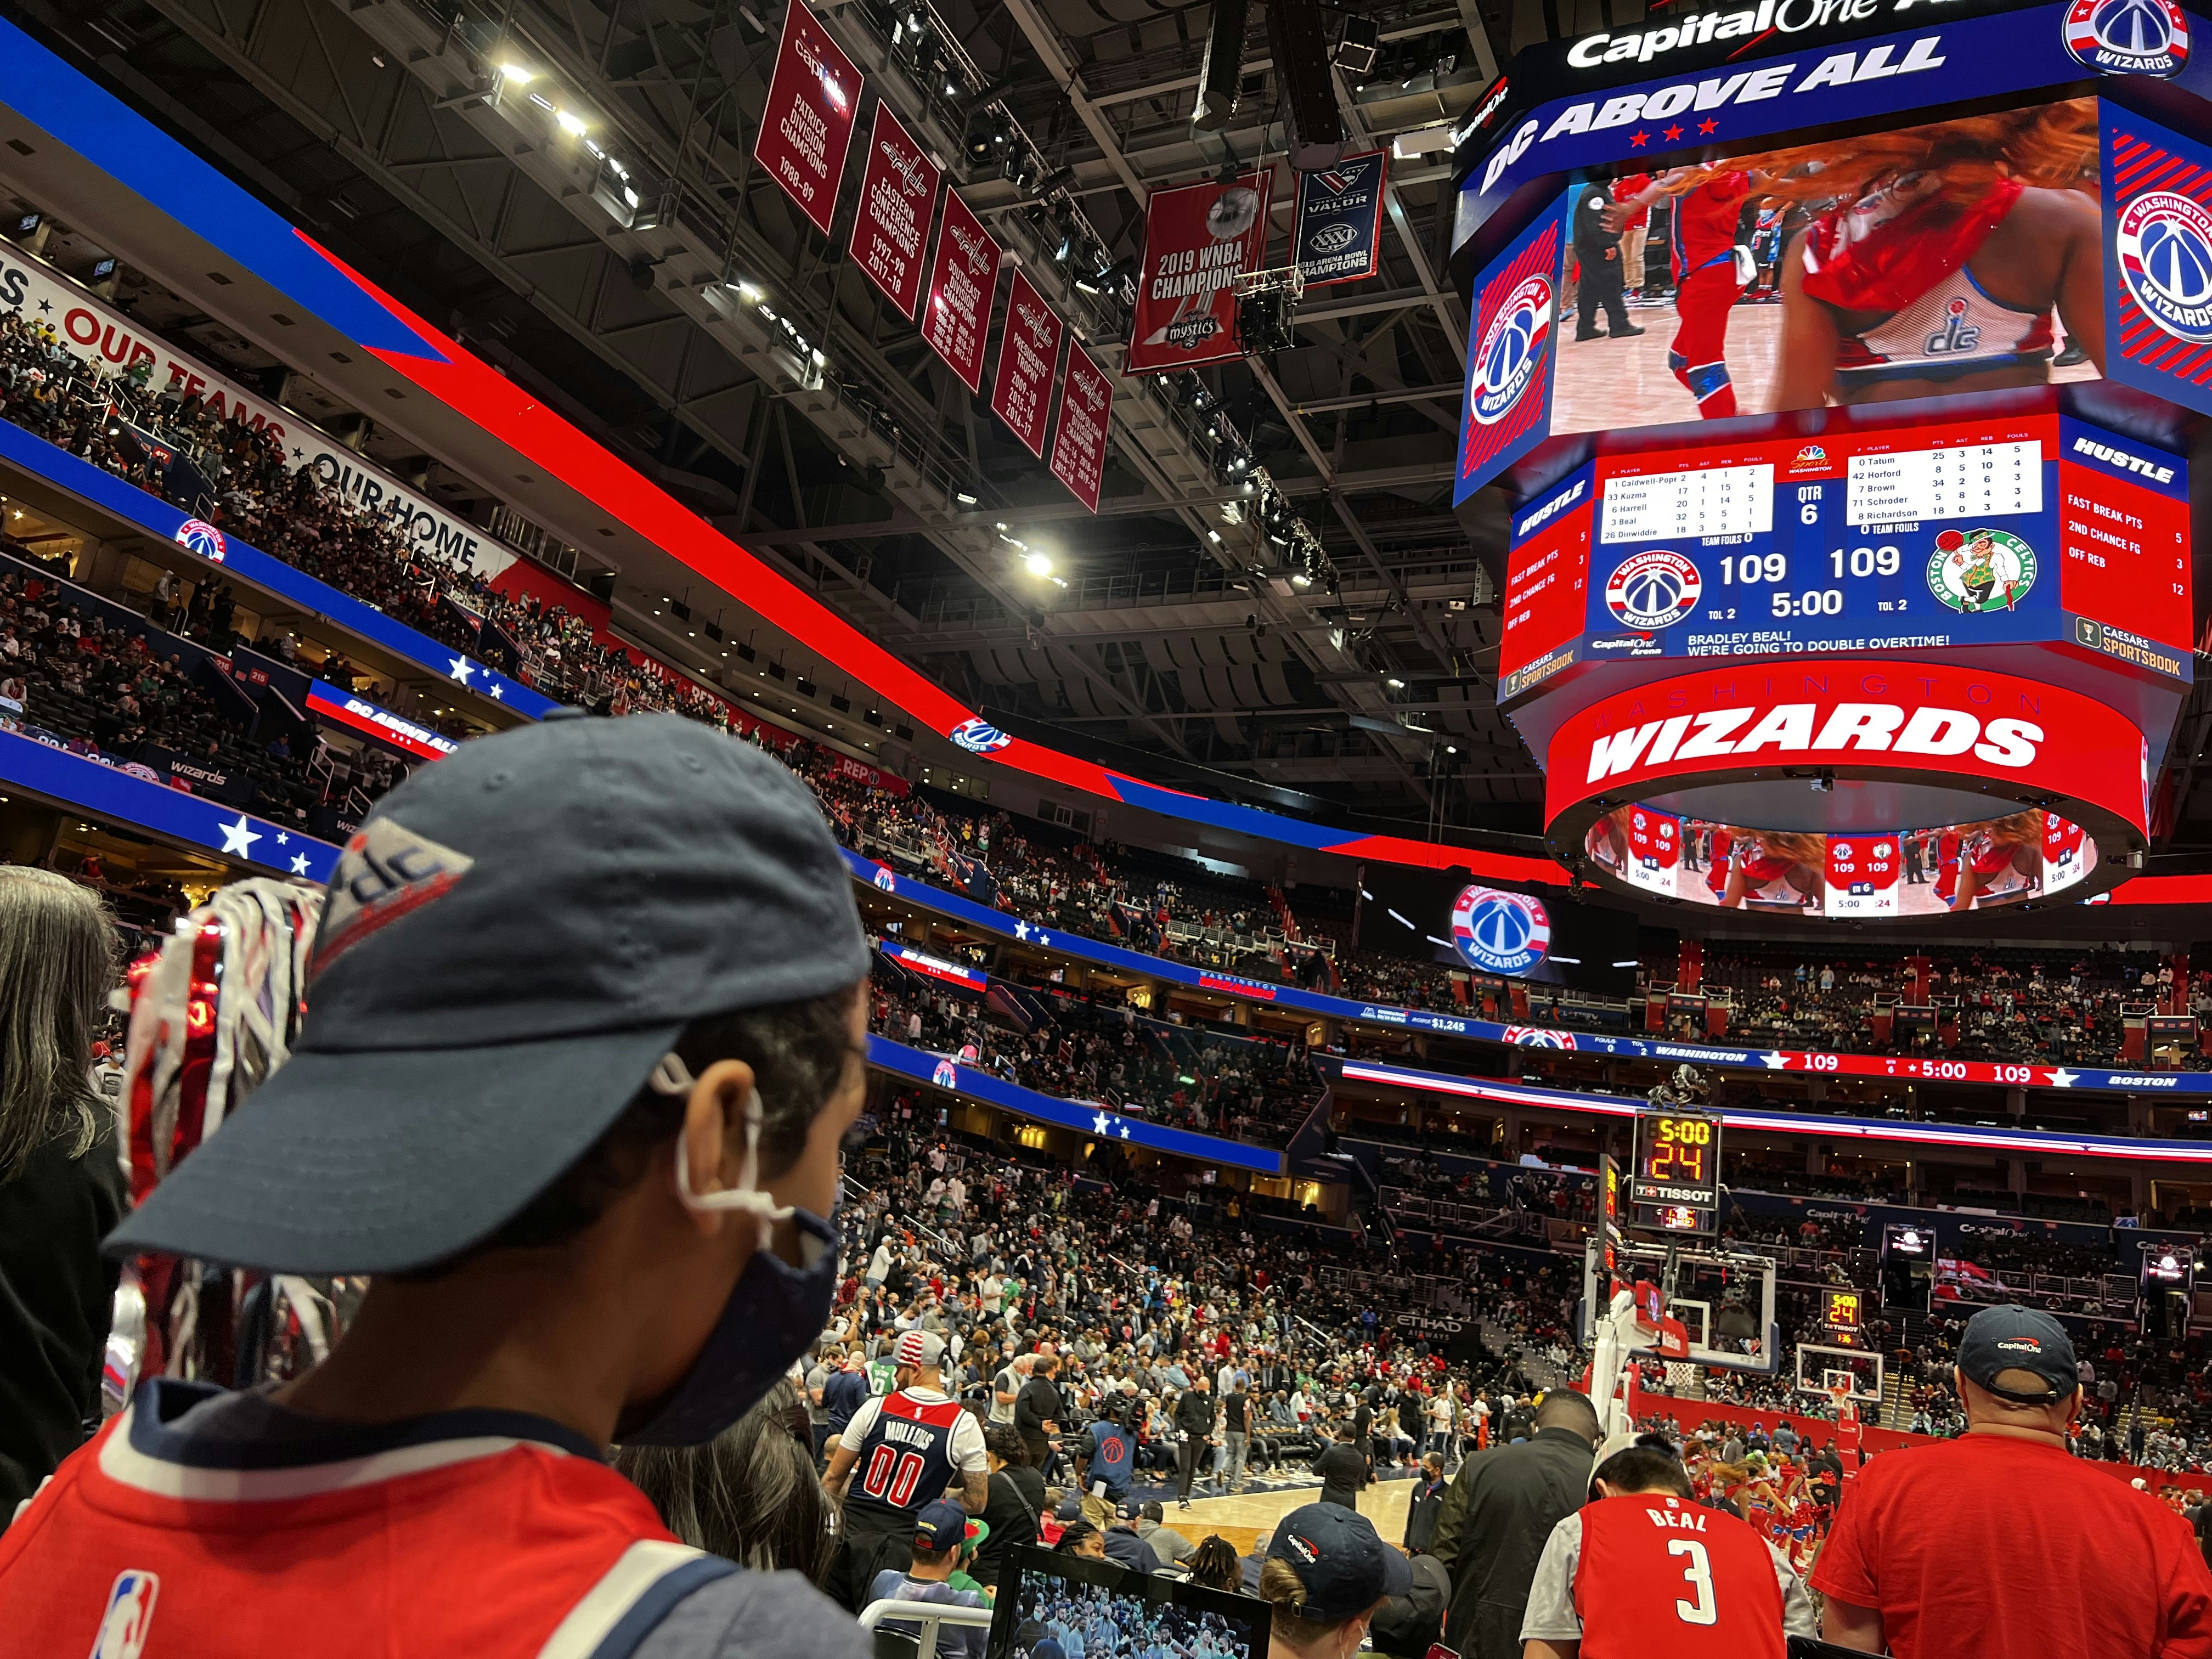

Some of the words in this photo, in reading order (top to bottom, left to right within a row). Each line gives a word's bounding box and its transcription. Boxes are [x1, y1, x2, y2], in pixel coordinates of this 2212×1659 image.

[2094, 49, 2174, 70] WIZARDS
[794, 93, 827, 141] PATRICK
[1480, 120, 1539, 196] DC
[1540, 63, 1797, 143] ABOVE
[1794, 36, 1946, 93] ALL
[790, 107, 826, 158] DIVISION
[780, 116, 827, 179] CHAMPIONS
[780, 155, 814, 202] 1988-89
[881, 177, 915, 221] EASTERN
[1308, 195, 1367, 213] VALOR
[871, 184, 921, 248] CONFERENCE
[870, 201, 915, 259] CHAMPIONS
[872, 233, 905, 277] 1997-98
[1158, 249, 1195, 276] 2019
[1199, 240, 1243, 268] WNBA
[1316, 255, 1344, 266] ARENA
[1344, 250, 1368, 261] BOWL
[868, 250, 902, 294] 2017-18
[948, 258, 981, 303] SOUTHEAST
[943, 283, 977, 329] CHAMPIONS
[1485, 282, 1541, 346] WASHINGTON
[1017, 352, 1039, 385] TROPHY
[1011, 370, 1037, 407] 2009-10
[1481, 357, 1532, 411] WIZARDS
[1008, 386, 1034, 423] 2015-16
[1066, 394, 1103, 442] METROPOLITAN
[1005, 402, 1032, 438] 2016-17
[1066, 422, 1096, 460] CHAMPIONS
[1789, 466, 1833, 474] WASHINGTON
[1790, 458, 1831, 469] Sports
[1859, 458, 1865, 466] 0
[1868, 457, 1895, 466] Tatum
[2073, 437, 2175, 484] HUSTLE
[1852, 472, 1865, 480] 42
[1867, 469, 1901, 479] Horford
[1867, 483, 1895, 493] Brown
[1518, 479, 1586, 537] HUSTLE
[1620, 504, 1647, 512] Harrell
[1621, 492, 1647, 500] Kuzma
[1797, 485, 1822, 504] QTR
[1867, 496, 1909, 506] Schroder
[1800, 504, 1819, 525] 6
[1858, 512, 1864, 521] 8
[1867, 509, 1918, 520] Richardson
[1860, 523, 1870, 535] 0
[1872, 524, 1893, 535] TEAM
[1894, 521, 1920, 533] FOULS
[2068, 494, 2091, 511] FAST
[2093, 501, 2124, 522] BREAK
[2125, 514, 2143, 529] PTS
[2175, 533, 2182, 543] 5
[391, 495, 478, 566] HOME
[1618, 528, 1658, 538] Dinwiddie
[1702, 537, 1720, 546] TEAM
[1721, 535, 1742, 545] FOULS
[1743, 532, 1753, 543] 0
[2068, 520, 2088, 535] 2ND
[2090, 528, 2127, 550] CHANCE
[2129, 541, 2141, 555] FG
[2176, 558, 2183, 569] 3
[1618, 554, 1691, 577] WASHINGTON
[1719, 552, 1787, 585] 109
[1830, 545, 1901, 579] 109
[2006, 538, 2032, 588] CELTICS
[2068, 546, 2086, 561] OFF
[2087, 553, 2106, 568] REB
[2172, 583, 2184, 596] 12
[1929, 550, 1951, 602] BOSTON
[1708, 611, 1723, 620] TOL
[1726, 608, 1736, 619] 2
[1771, 589, 1843, 618] 5:00
[1878, 601, 1894, 612] TOL
[1898, 599, 1908, 611] 2
[1622, 608, 1681, 627] WIZARDS
[1688, 633, 1748, 645] BRADLEY
[1752, 630, 1791, 642] BEAL!
[1688, 644, 1729, 657] WE'RE
[1733, 643, 1781, 654] GOING
[1784, 641, 1803, 653] TO
[1808, 638, 1865, 652] DOUBLE
[1869, 635, 1950, 649] OVERTIME!
[2102, 626, 2149, 650] CAESARS
[1522, 651, 1554, 675] CAESARS
[1630, 647, 1662, 656] Arena
[2102, 637, 2181, 676] SPORTSBOOK
[251, 670, 266, 684] 215
[1521, 650, 1573, 689] SPORTSBOOK
[1593, 674, 2041, 733] WASHINGTON
[344, 699, 374, 719] DC
[371, 712, 432, 743] ABOVE
[1585, 702, 2045, 786] WIZARDS
[843, 759, 868, 780] REP
[1833, 862, 1855, 873] 109
[1866, 862, 1889, 872] 109
[1838, 899, 1860, 909] 5:00
[1875, 899, 1891, 909] :24
[1468, 941, 1532, 969] WIZARDS
[1431, 1017, 1466, 1032] $1,245
[1594, 1036, 1617, 1045] FOULS
[1655, 1046, 1748, 1063] WASHINGTON
[1803, 1053, 1838, 1071] 109
[1922, 1060, 1967, 1079] 5:00
[1993, 1065, 2032, 1082] 109
[2108, 1075, 2177, 1087] BOSTON
[1660, 1119, 1711, 1146] 5:00
[1651, 1141, 1703, 1181] 24
[1657, 1186, 1713, 1203] TISSOT
[1829, 1304, 1854, 1324] 24
[1832, 1294, 1858, 1308] 5:00
[1396, 1314, 1463, 1333] ETIHAD
[884, 1420, 935, 1451] MULLINS
[863, 1443, 926, 1508] 00
[1645, 1508, 1708, 1533] BEAL
[1666, 1538, 1718, 1627] 3
